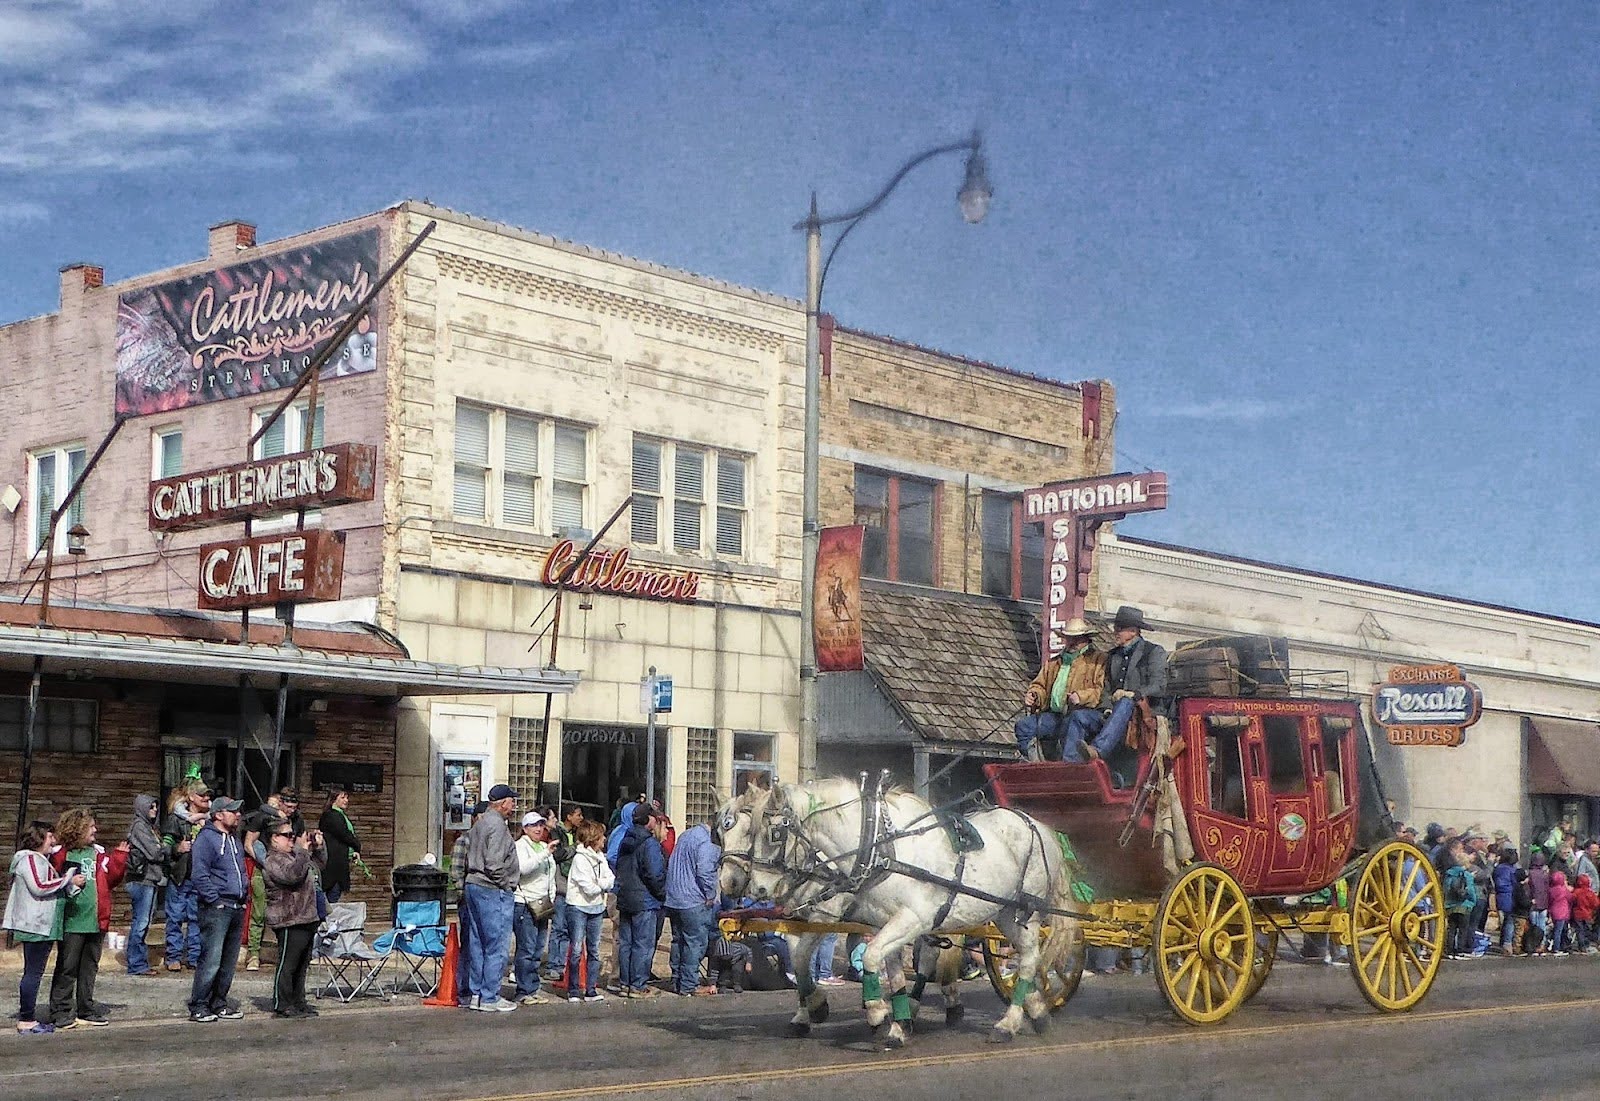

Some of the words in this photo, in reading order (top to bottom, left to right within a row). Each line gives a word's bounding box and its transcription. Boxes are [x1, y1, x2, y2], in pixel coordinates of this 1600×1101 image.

[191, 262, 374, 342] Cattlemen's
[191, 344, 371, 391] STEAKHOSE
[152, 450, 338, 521] CATTLEMEN'S
[1028, 480, 1147, 516] NATIONAL
[201, 536, 306, 599] CAFE
[1049, 518, 1070, 659] SADDLE
[1393, 667, 1455, 681] EXCHANGE
[1380, 686, 1468, 721] Rexall
[1391, 728, 1453, 742] DRUGS
